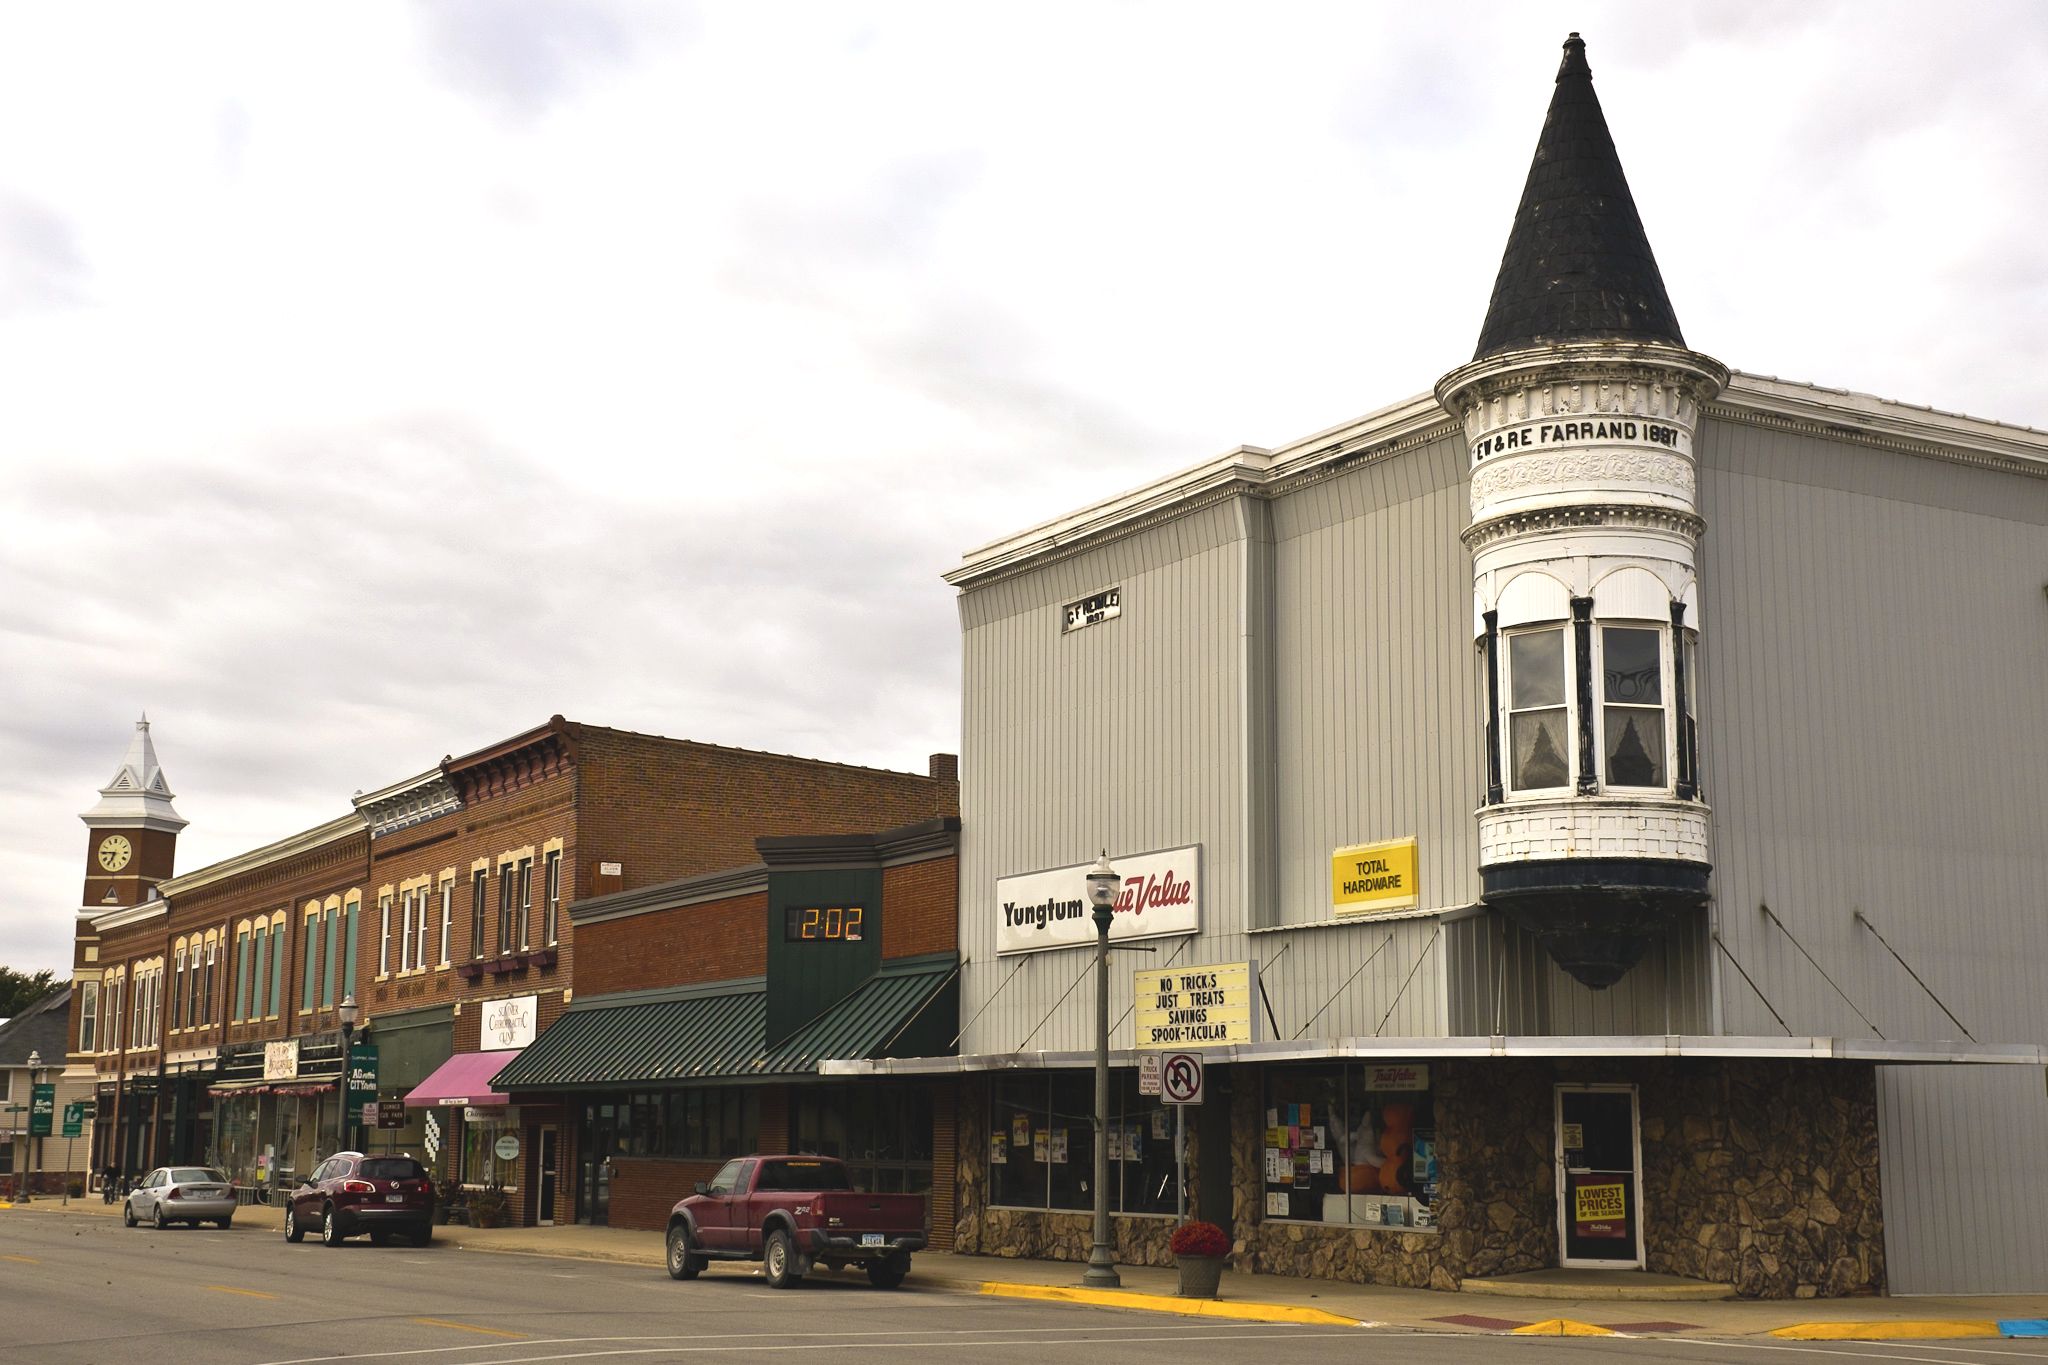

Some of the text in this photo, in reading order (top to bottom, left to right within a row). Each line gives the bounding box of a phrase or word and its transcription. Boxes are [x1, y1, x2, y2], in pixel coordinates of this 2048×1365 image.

[1540, 421, 1637, 443] FARRAND
[1355, 859, 1390, 875] TOTAL
[1343, 874, 1402, 895] HARDWARE
[1003, 898, 1083, 930] Yungtum
[1124, 869, 1191, 915] Value
[802, 908, 862, 939] 2:02
[1160, 978, 1173, 992] NO
[1156, 990, 1225, 1009] JUST TREATS
[1168, 1008, 1208, 1025] SAVINGS
[1151, 1024, 1227, 1042] SPOOK-TACULAR
[1141, 1073, 1160, 1081] PARKING
[1143, 1065, 1158, 1073] TRUCK
[1373, 1067, 1417, 1083] True Value
[1577, 1187, 1621, 1199] LOWEST
[1578, 1198, 1623, 1211] PRICES
